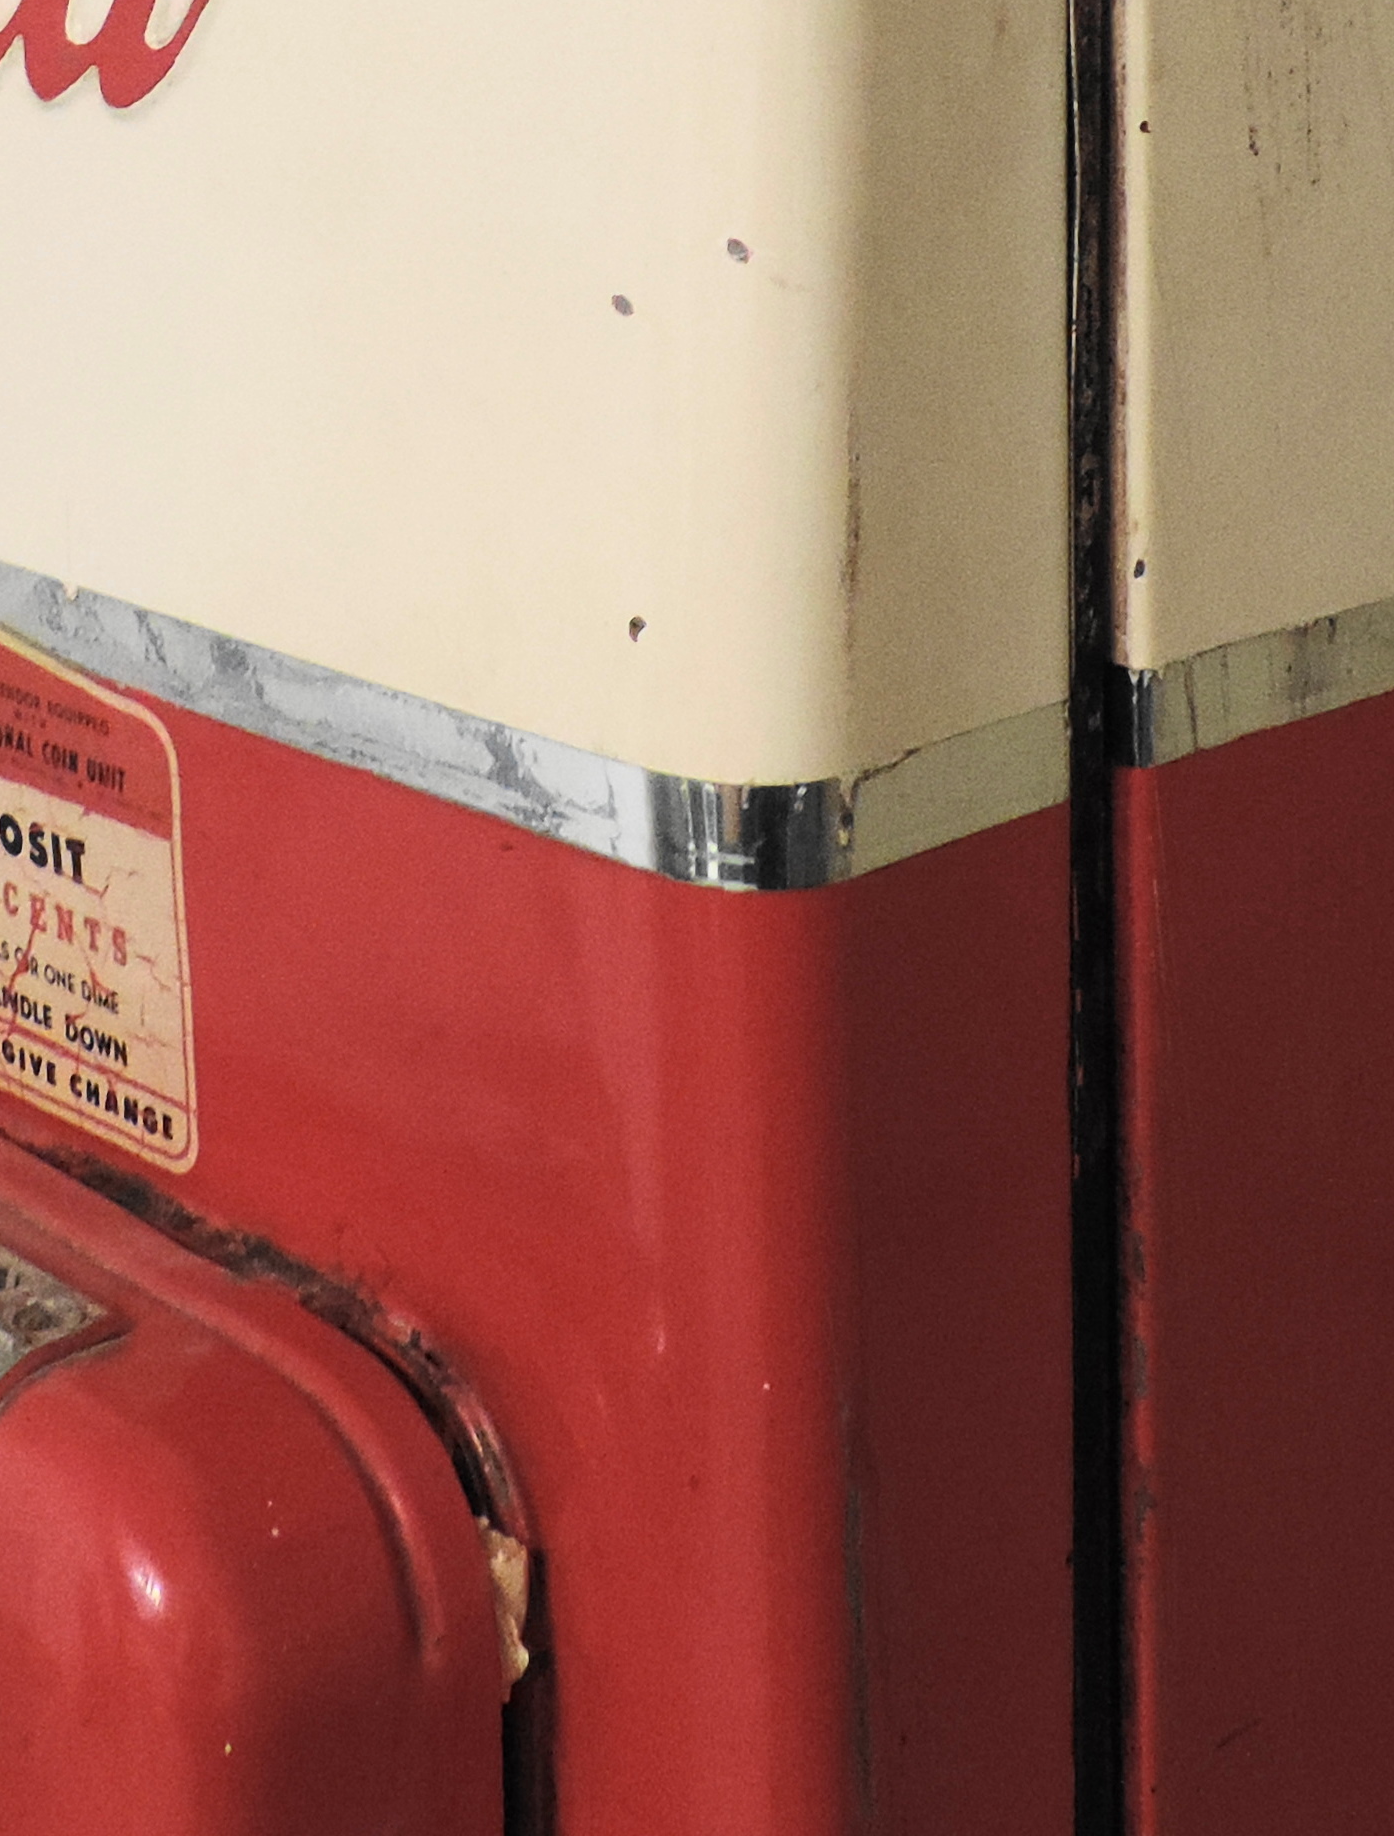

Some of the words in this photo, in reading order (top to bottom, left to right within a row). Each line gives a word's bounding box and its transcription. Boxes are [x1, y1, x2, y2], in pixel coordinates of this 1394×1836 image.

[42, 739, 79, 775] COIN
[86, 757, 126, 794] UNIT
[3, 880, 127, 966] CENTS
[43, 963, 75, 994] ONE
[81, 979, 119, 1014] DIME
[65, 1013, 128, 1068] DOWN
[1, 1038, 57, 1087] GIVE
[69, 1073, 174, 1141] CHANGE
